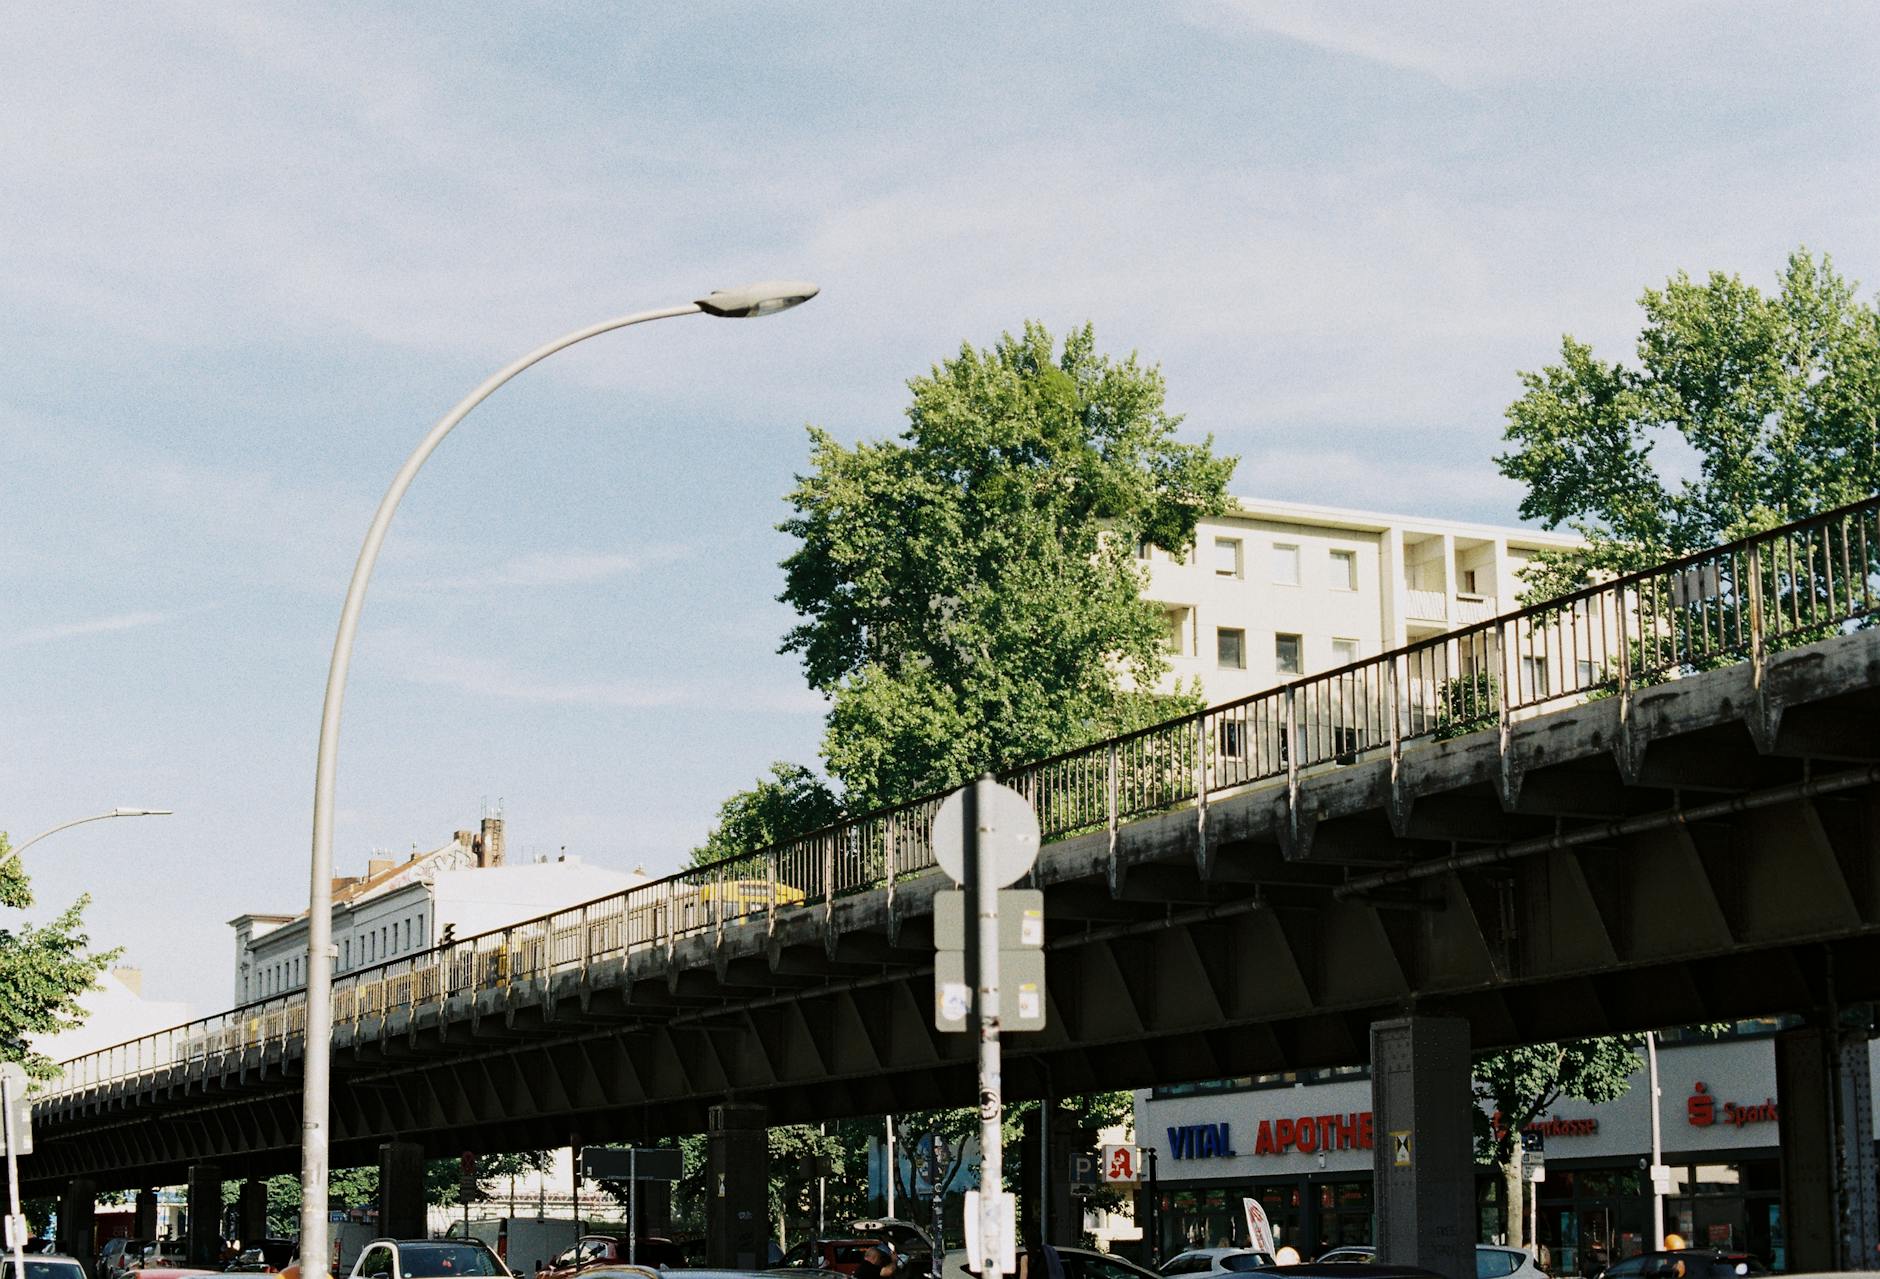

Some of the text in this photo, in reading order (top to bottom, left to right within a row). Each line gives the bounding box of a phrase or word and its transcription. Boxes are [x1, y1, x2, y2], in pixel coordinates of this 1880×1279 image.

[1167, 1111, 1374, 1160] VITAL APOTHE
[1076, 1157, 1092, 1183] P
